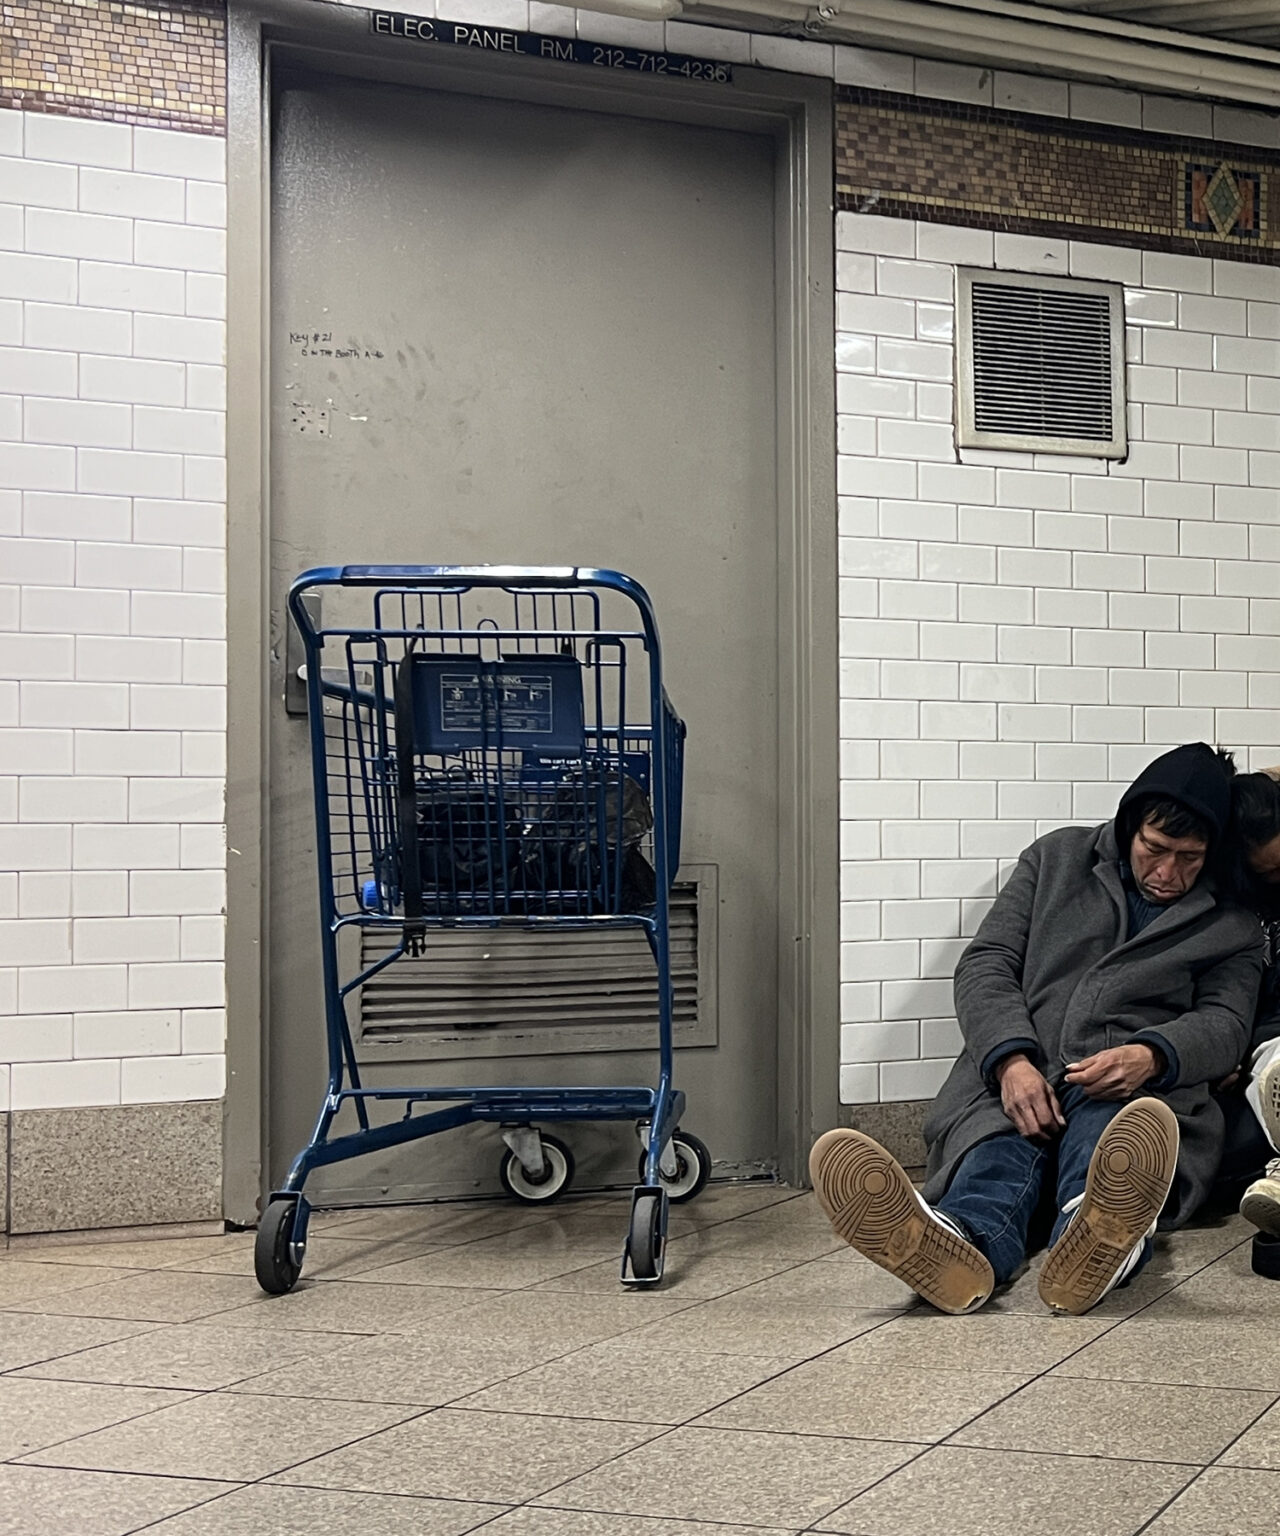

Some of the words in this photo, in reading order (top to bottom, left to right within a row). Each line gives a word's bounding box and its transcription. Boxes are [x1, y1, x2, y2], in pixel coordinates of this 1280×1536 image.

[375, 14, 439, 42] ELEC.
[453, 26, 527, 55] PANEL
[540, 39, 578, 62] RM.
[592, 47, 730, 84] 212-712-4236
